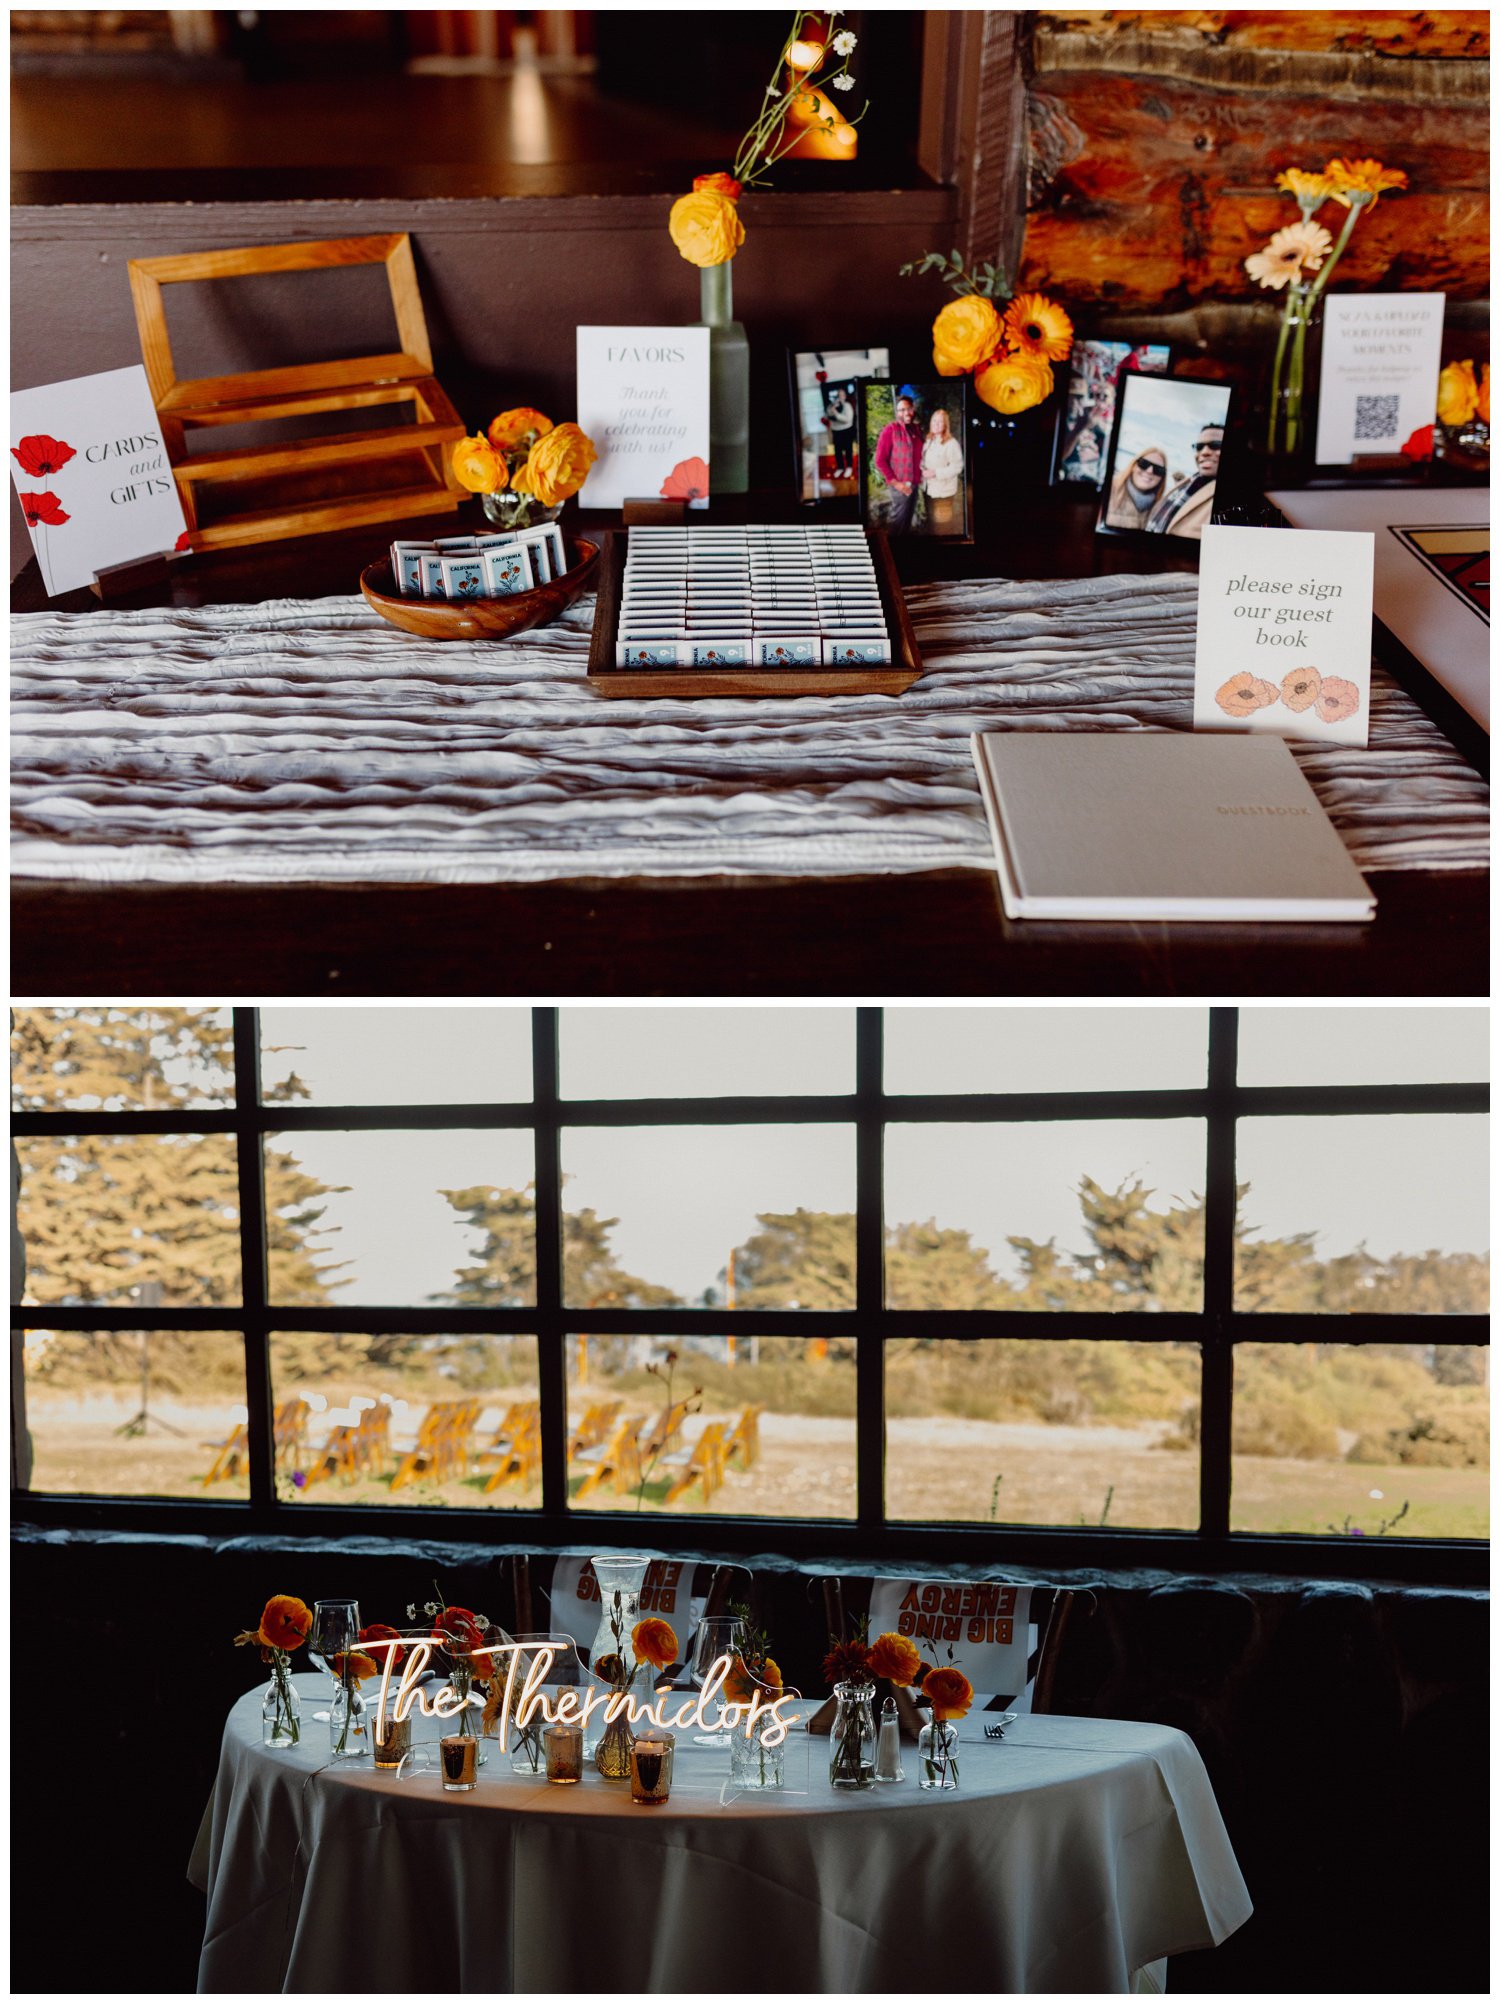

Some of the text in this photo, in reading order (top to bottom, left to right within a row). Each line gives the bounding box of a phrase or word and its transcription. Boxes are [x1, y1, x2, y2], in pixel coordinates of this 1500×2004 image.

[607, 347, 685, 363] FAVORS
[620, 387, 669, 400] Thank
[619, 405, 674, 422] you for
[604, 424, 688, 438] celebrating
[85, 432, 159, 464] CARDS
[606, 441, 642, 453] with
[130, 454, 163, 476] and
[110, 476, 171, 505] GIFTS
[450, 564, 480, 572] CALIFORNIA
[491, 553, 522, 563] CALIFORNIA
[1225, 575, 1343, 601] please sign
[1233, 605, 1335, 625] our guest
[1255, 627, 1309, 649] book
[1216, 805, 1312, 816] GUESTBOOK
[898, 1582, 1018, 1616] ENERGY
[898, 1611, 1013, 1645] BIG RING
[349, 1637, 802, 1754] The Thermidors
